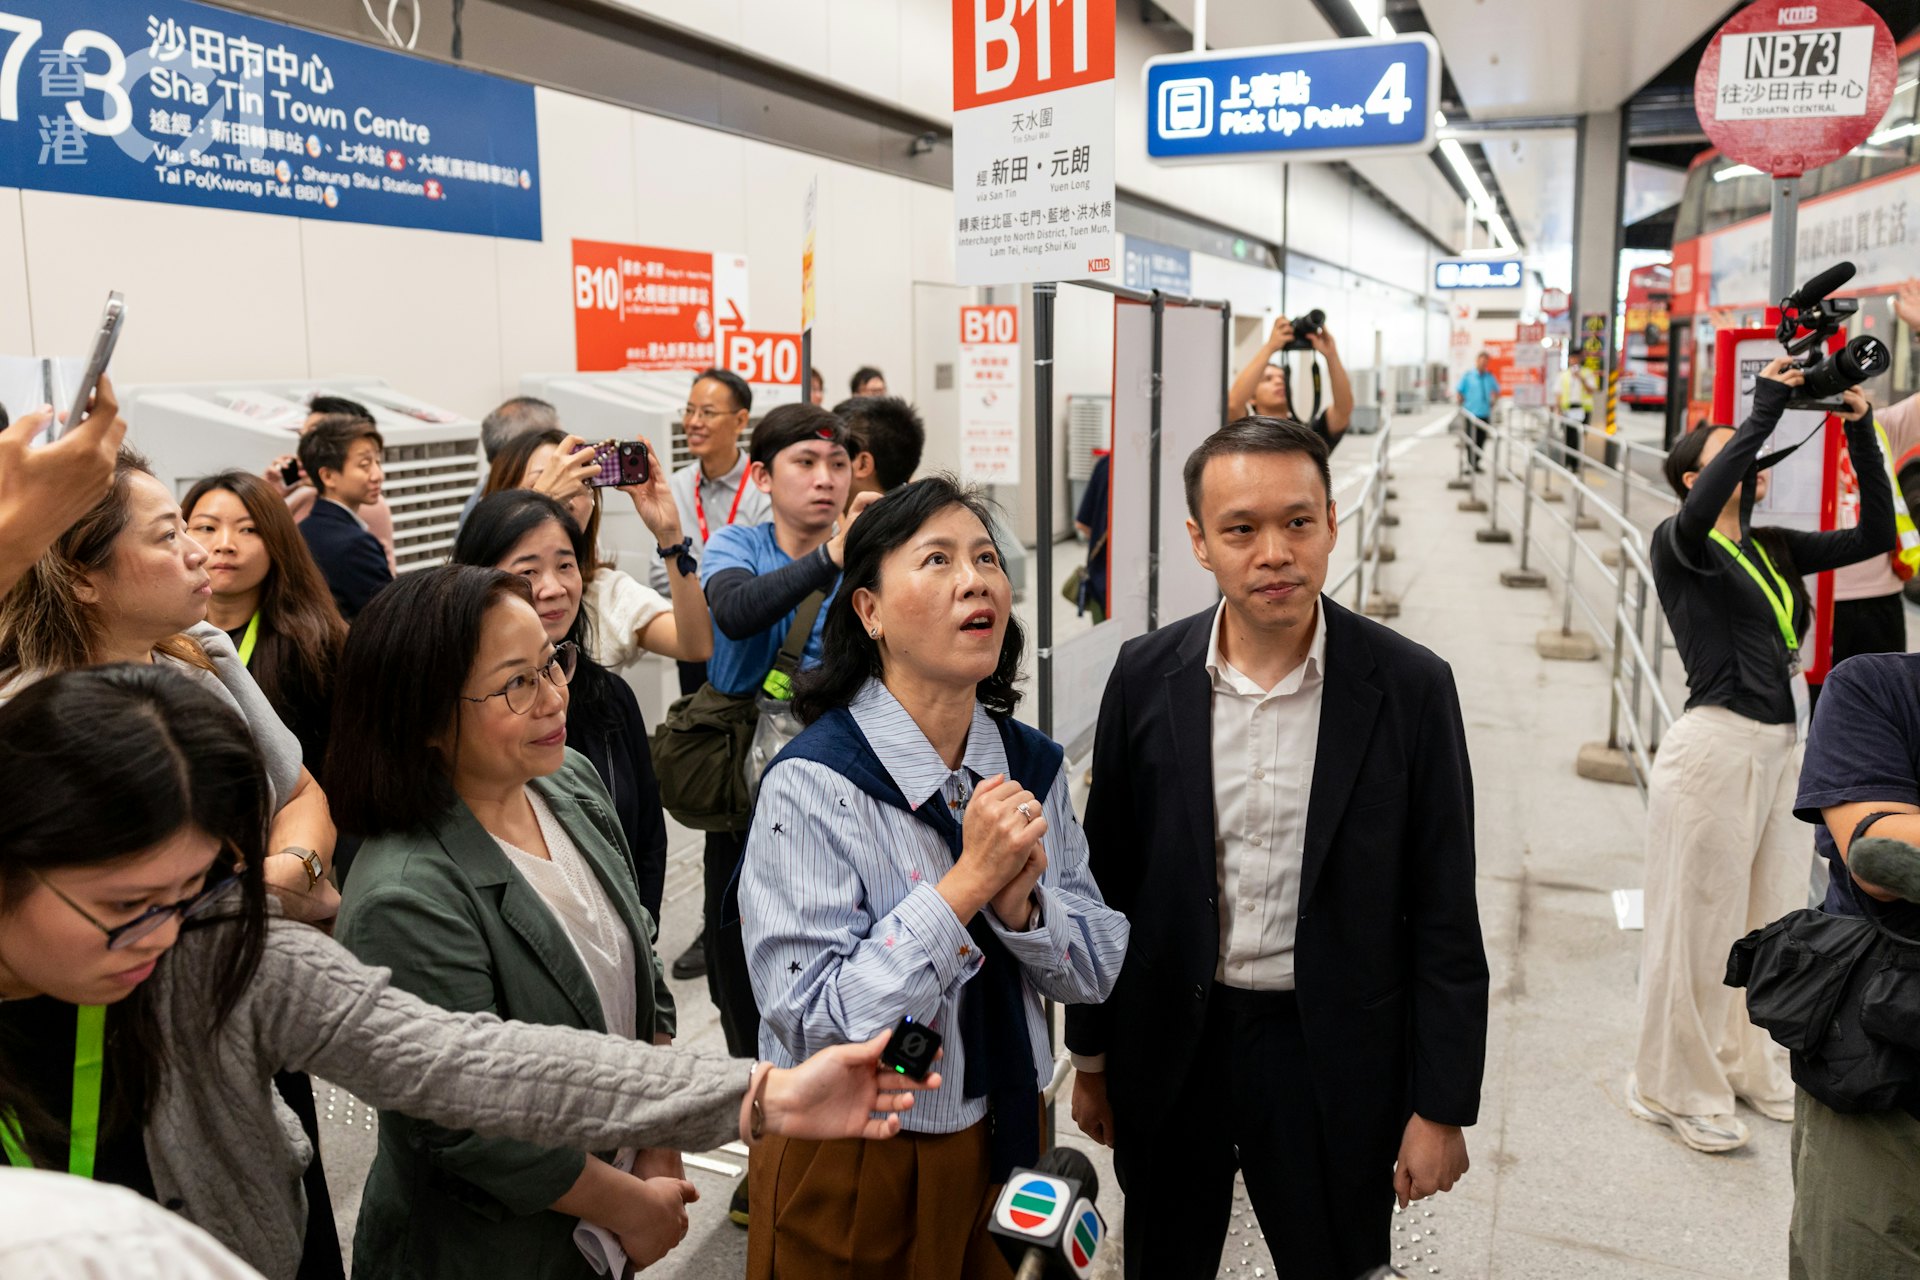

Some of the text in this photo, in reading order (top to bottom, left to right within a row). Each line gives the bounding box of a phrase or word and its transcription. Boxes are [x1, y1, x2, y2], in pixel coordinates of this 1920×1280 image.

[1777, 6, 1818, 26] KMB
[146, 14, 334, 95] 沙田市中心
[974, 0, 1088, 95] B11
[1748, 32, 1837, 79] NB73
[150, 66, 430, 146] Sha Tin Town Centre
[1219, 61, 1413, 137] Pick Up Point 4
[1721, 79, 1864, 105] 往沙田市中心
[1011, 106, 1053, 134] 天水圍
[1741, 104, 1838, 116] TO SHATIN CENTRAL
[1013, 135, 1022, 145] Tin
[1024, 132, 1037, 143] Shui
[155, 164, 181, 185] Tai
[265, 178, 292, 200] Fuk
[189, 148, 220, 170] San
[222, 152, 248, 173] Tin
[301, 165, 351, 189] Sheung
[352, 171, 381, 191] Shui
[976, 188, 1017, 202] via San Tin
[1050, 179, 1090, 193] Yuen Long
[990, 240, 1077, 257] Lam Tei, Hung Shui Kiu
[1004, 233, 1012, 243] to
[1013, 231, 1035, 242] North
[1037, 227, 1068, 239] District,
[1070, 226, 1089, 236] Tuen
[1090, 224, 1110, 235] Mun,
[1087, 257, 1111, 273] KMB
[574, 264, 619, 311] B10
[964, 309, 1014, 343] B10
[729, 336, 798, 384] B10
